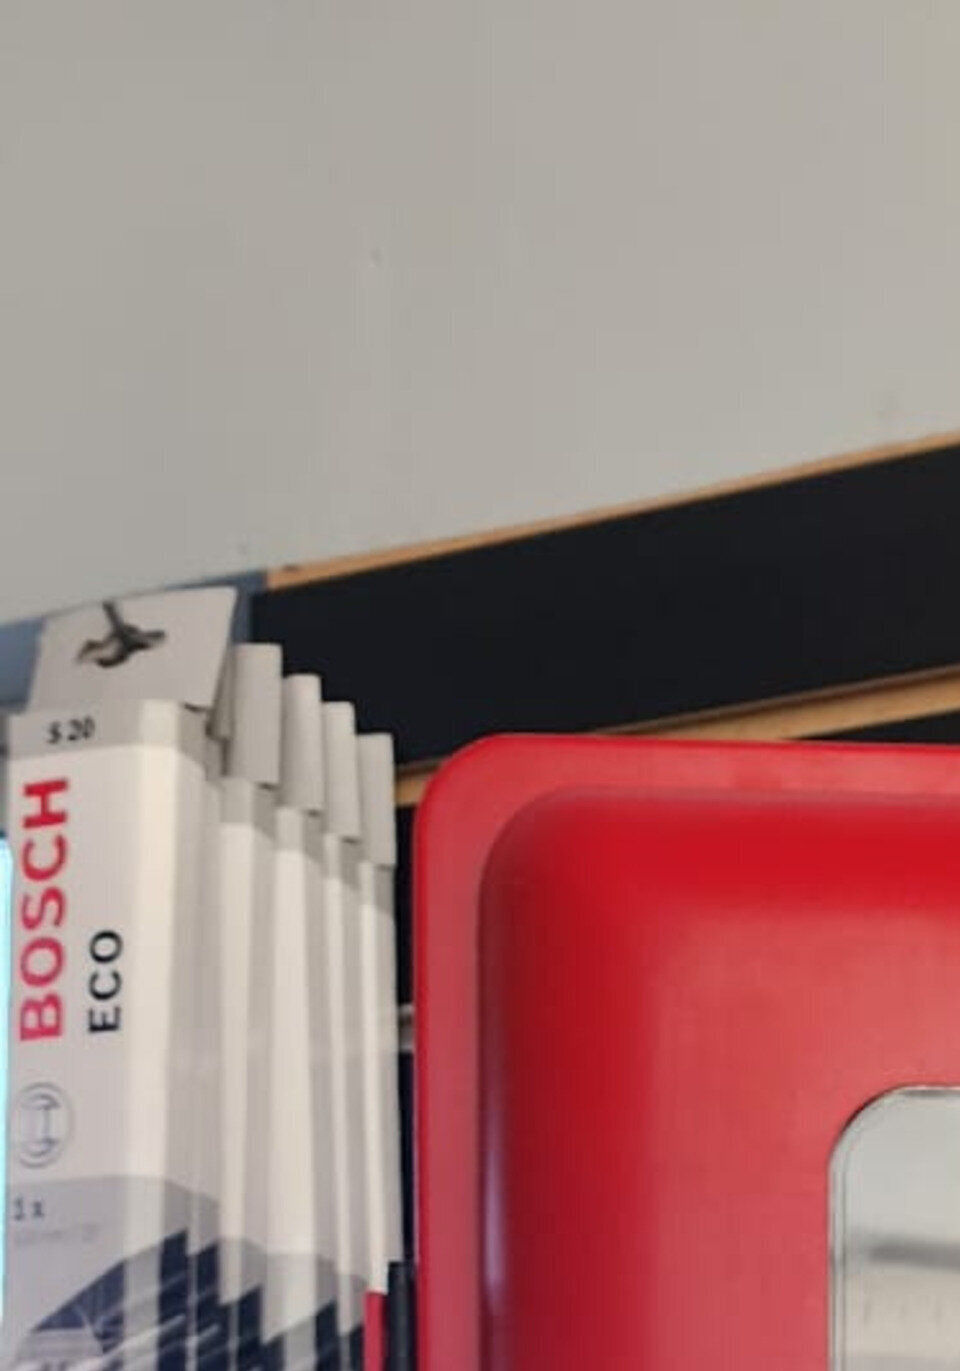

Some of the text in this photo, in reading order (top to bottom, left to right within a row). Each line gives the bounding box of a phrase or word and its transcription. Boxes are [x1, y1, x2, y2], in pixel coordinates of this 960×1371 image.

[47, 715, 95, 745] S 20
[20, 778, 68, 1041] BOSCH
[87, 929, 124, 1034] ECO
